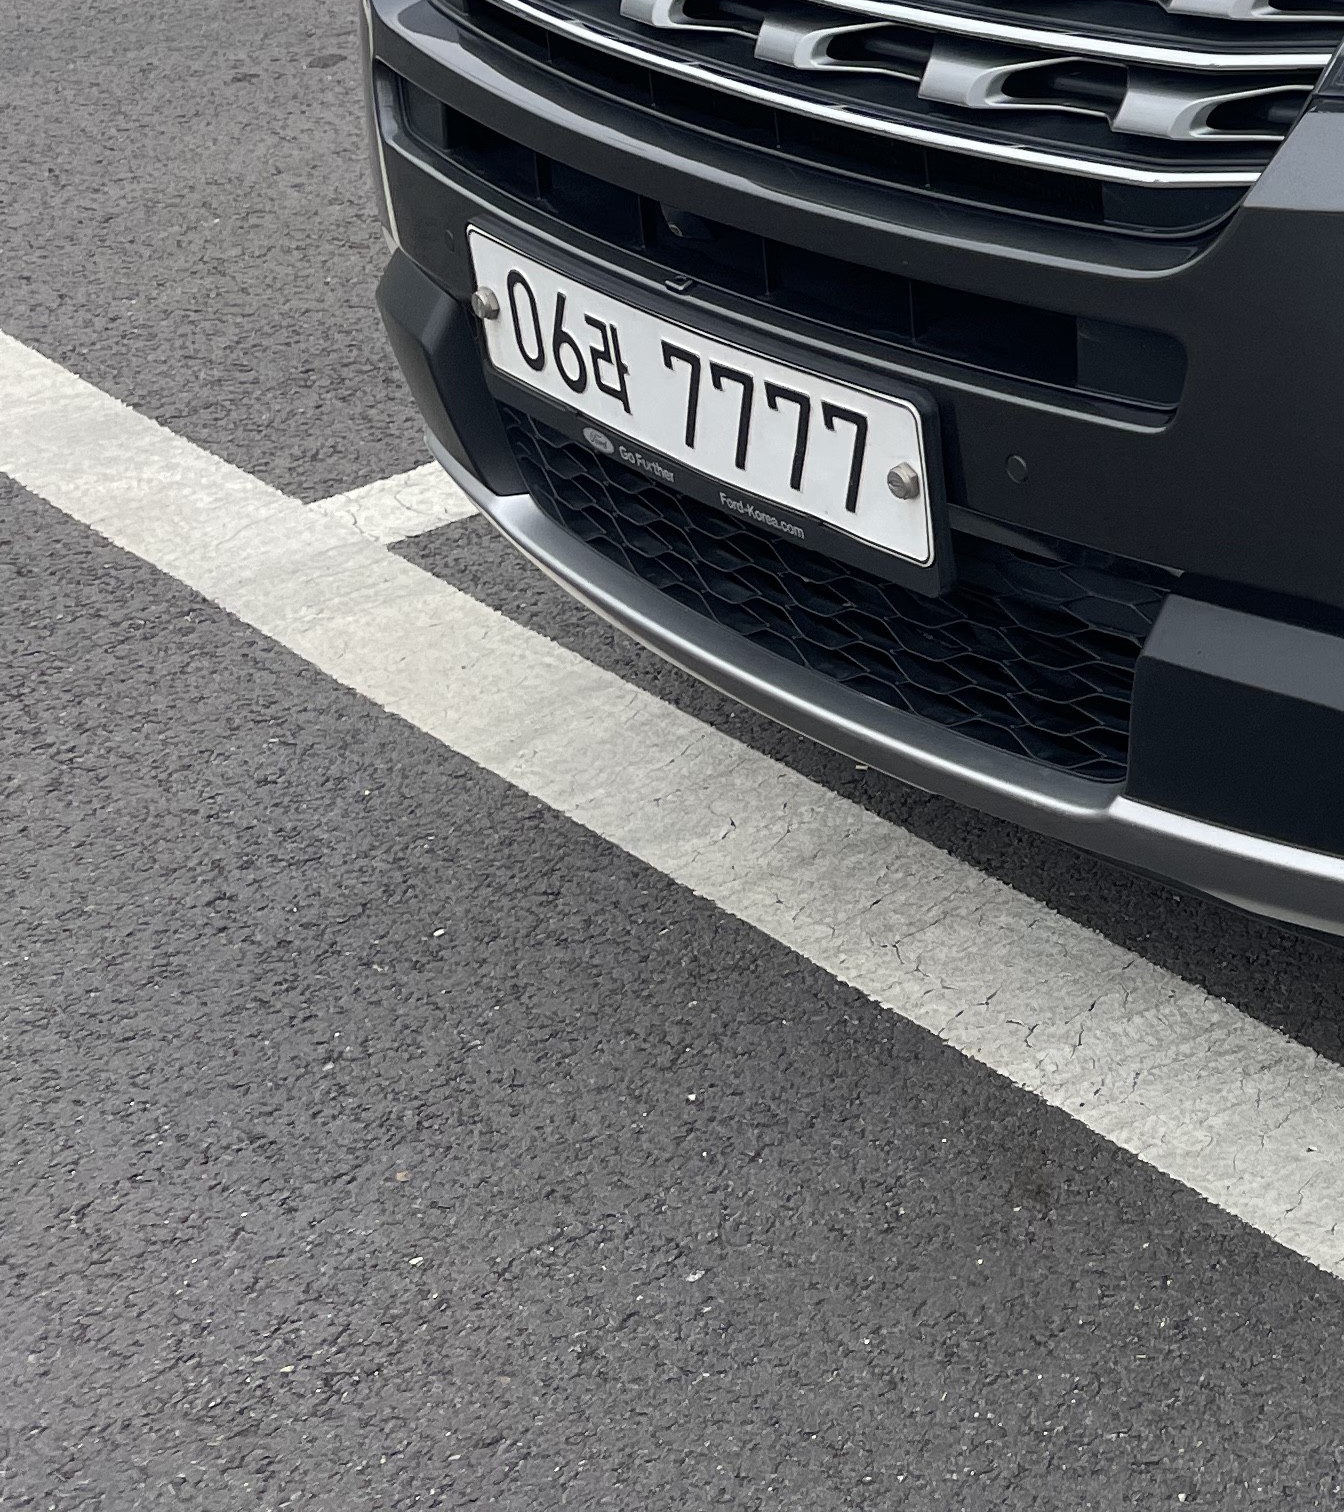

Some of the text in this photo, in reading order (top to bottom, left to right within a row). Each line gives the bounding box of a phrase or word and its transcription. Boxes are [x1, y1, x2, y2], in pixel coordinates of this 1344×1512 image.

[507, 268, 868, 513] 06라 7777
[619, 445, 675, 483] Go Further
[719, 492, 805, 539] Ford-Korea.com
